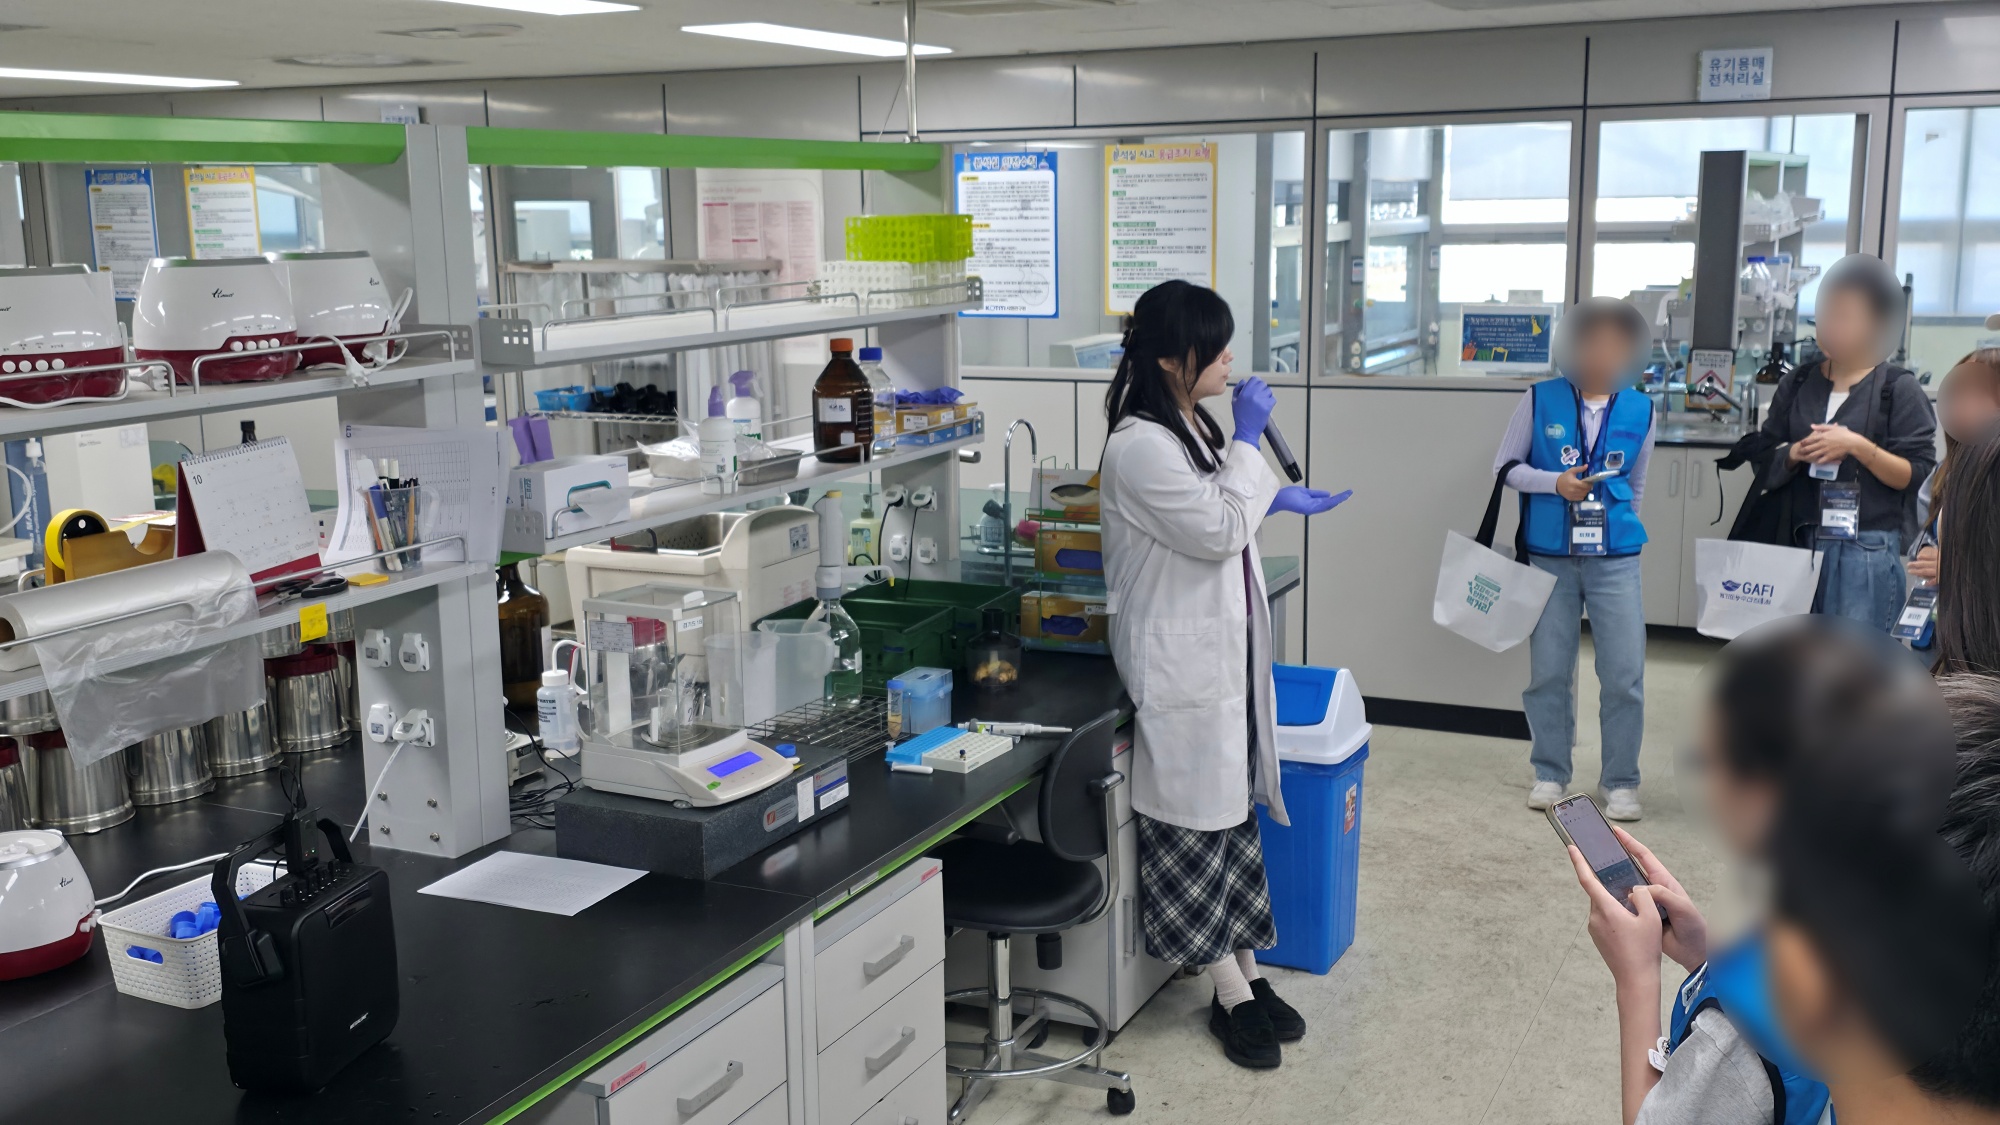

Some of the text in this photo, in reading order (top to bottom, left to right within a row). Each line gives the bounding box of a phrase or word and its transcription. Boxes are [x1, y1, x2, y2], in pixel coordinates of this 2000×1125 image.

[1709, 56, 1765, 72] 유기용매
[1708, 71, 1764, 87] 전처리실
[1002, 155, 1038, 170] 안전수칙
[1113, 149, 1136, 161] 분석실
[1139, 149, 1155, 159] 사고
[1159, 148, 1191, 160] 응급조치
[192, 474, 203, 485] 10
[1742, 581, 1775, 598] GAFI
[1466, 595, 1493, 614] 먹거리
